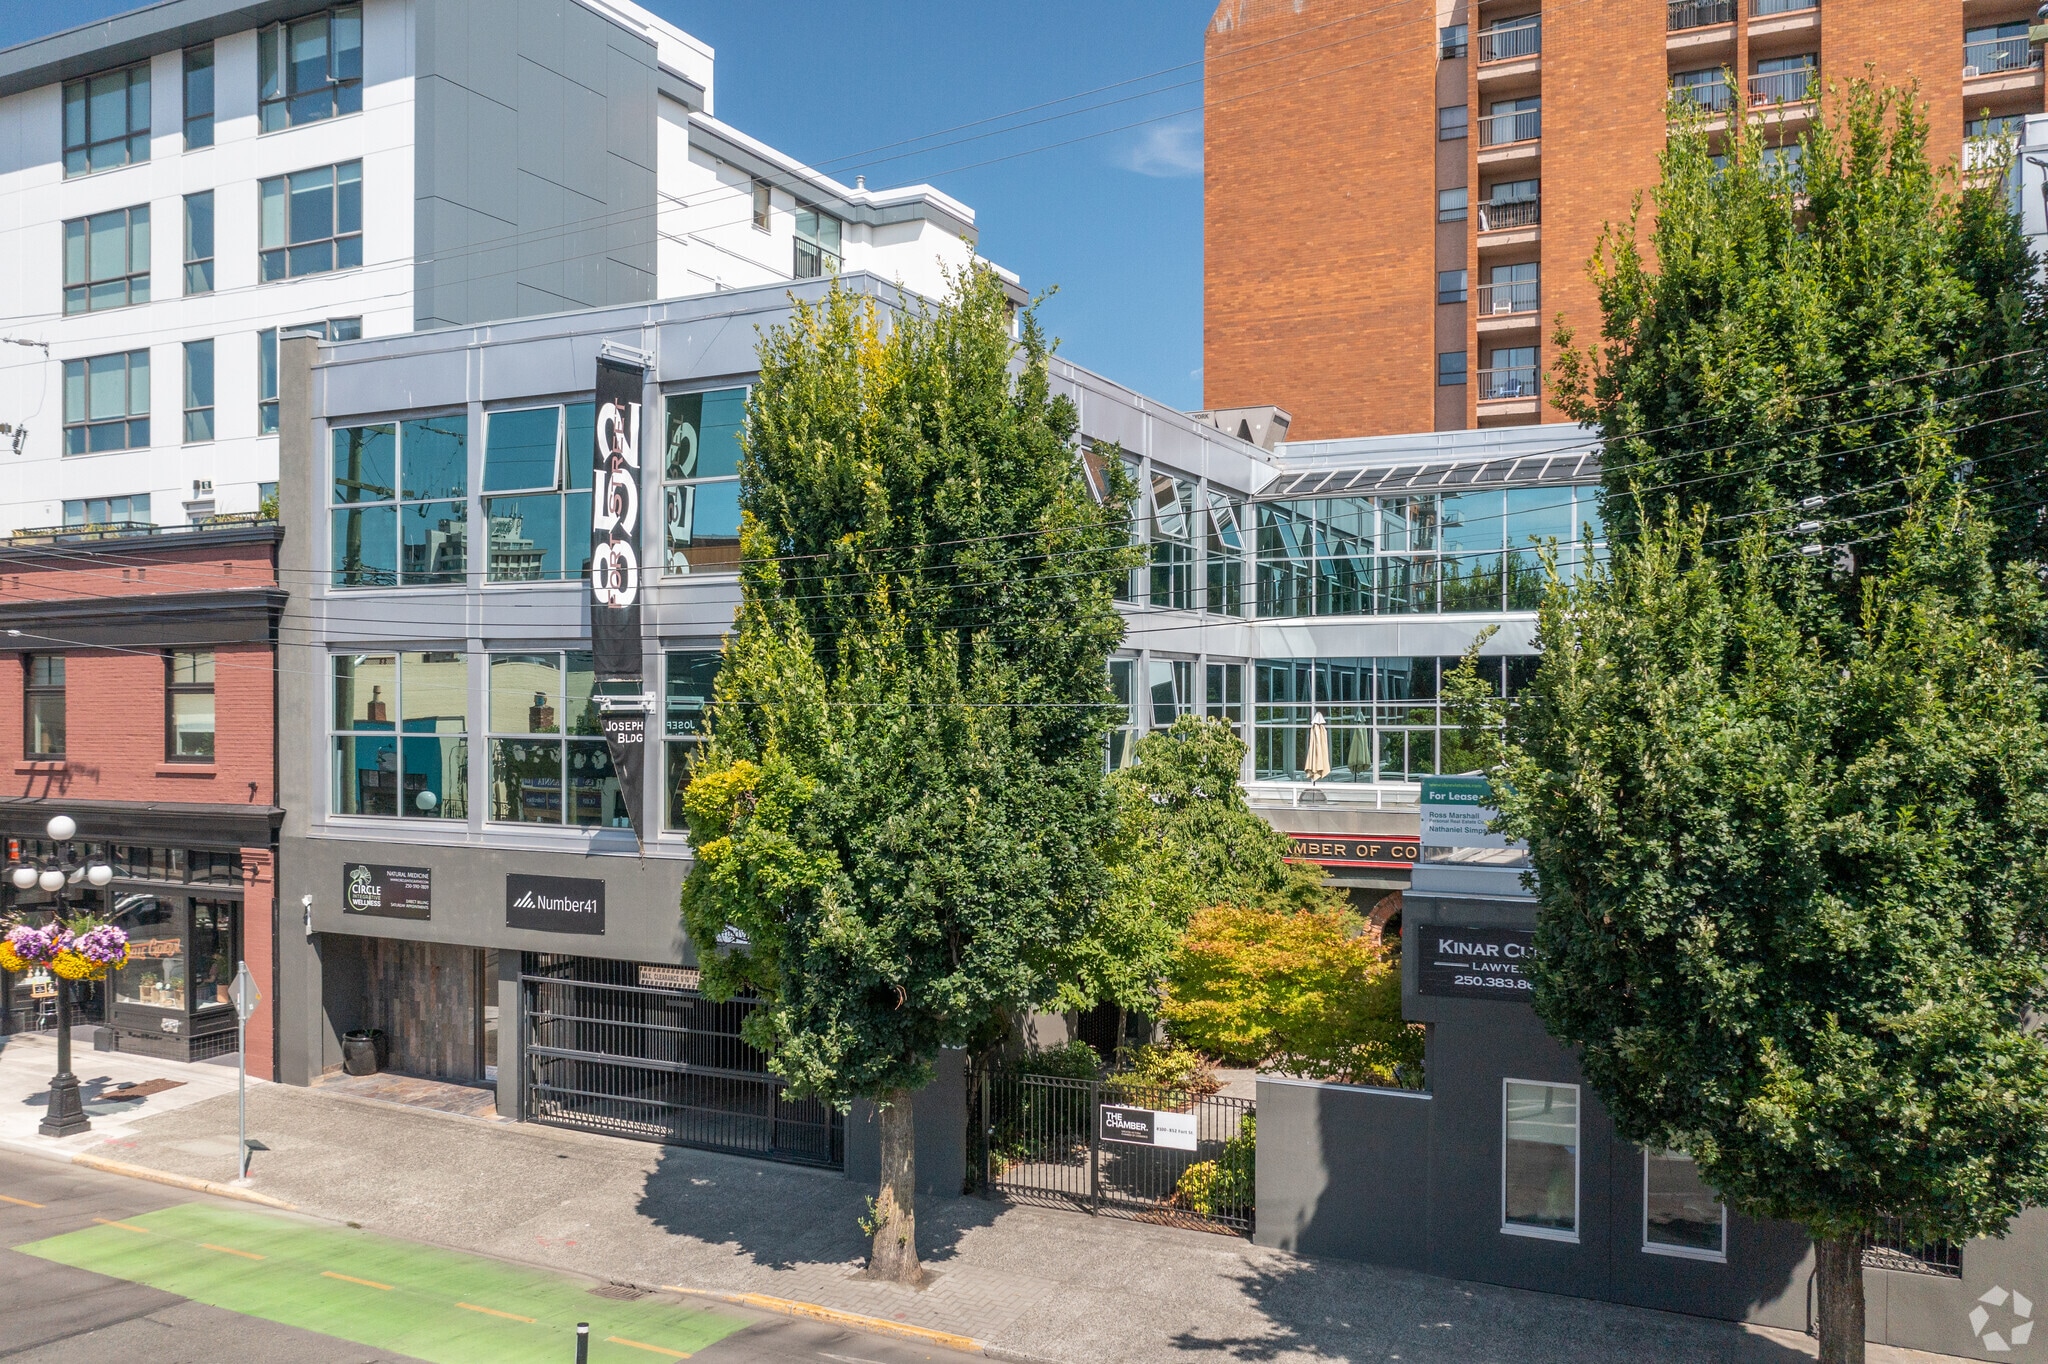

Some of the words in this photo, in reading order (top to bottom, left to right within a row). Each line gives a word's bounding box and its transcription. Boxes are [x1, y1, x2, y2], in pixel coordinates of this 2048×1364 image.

[608, 397, 626, 514] STREET
[592, 401, 642, 608] 852
[608, 533, 624, 609] FORT
[605, 721, 644, 732] JOSEPH
[617, 733, 643, 744] BLDG
[1429, 791, 1446, 800] For
[1449, 792, 1479, 801] Lease
[1429, 811, 1447, 819] Ross
[1449, 812, 1480, 820] Marshall
[1429, 825, 1463, 834] Nathaniel
[1356, 844, 1381, 857] OF
[1391, 846, 1418, 859] CO
[352, 884, 382, 896] CIRCLE
[352, 899, 382, 907] WELLNESS
[537, 894, 597, 914] Number41
[1438, 938, 1500, 958] KINAR
[1472, 962, 1529, 974] LAWYE
[654, 973, 680, 982] CLEARANCE
[1106, 1112, 1122, 1120] THE
[1105, 1119, 1149, 1132] CHAMBER.
